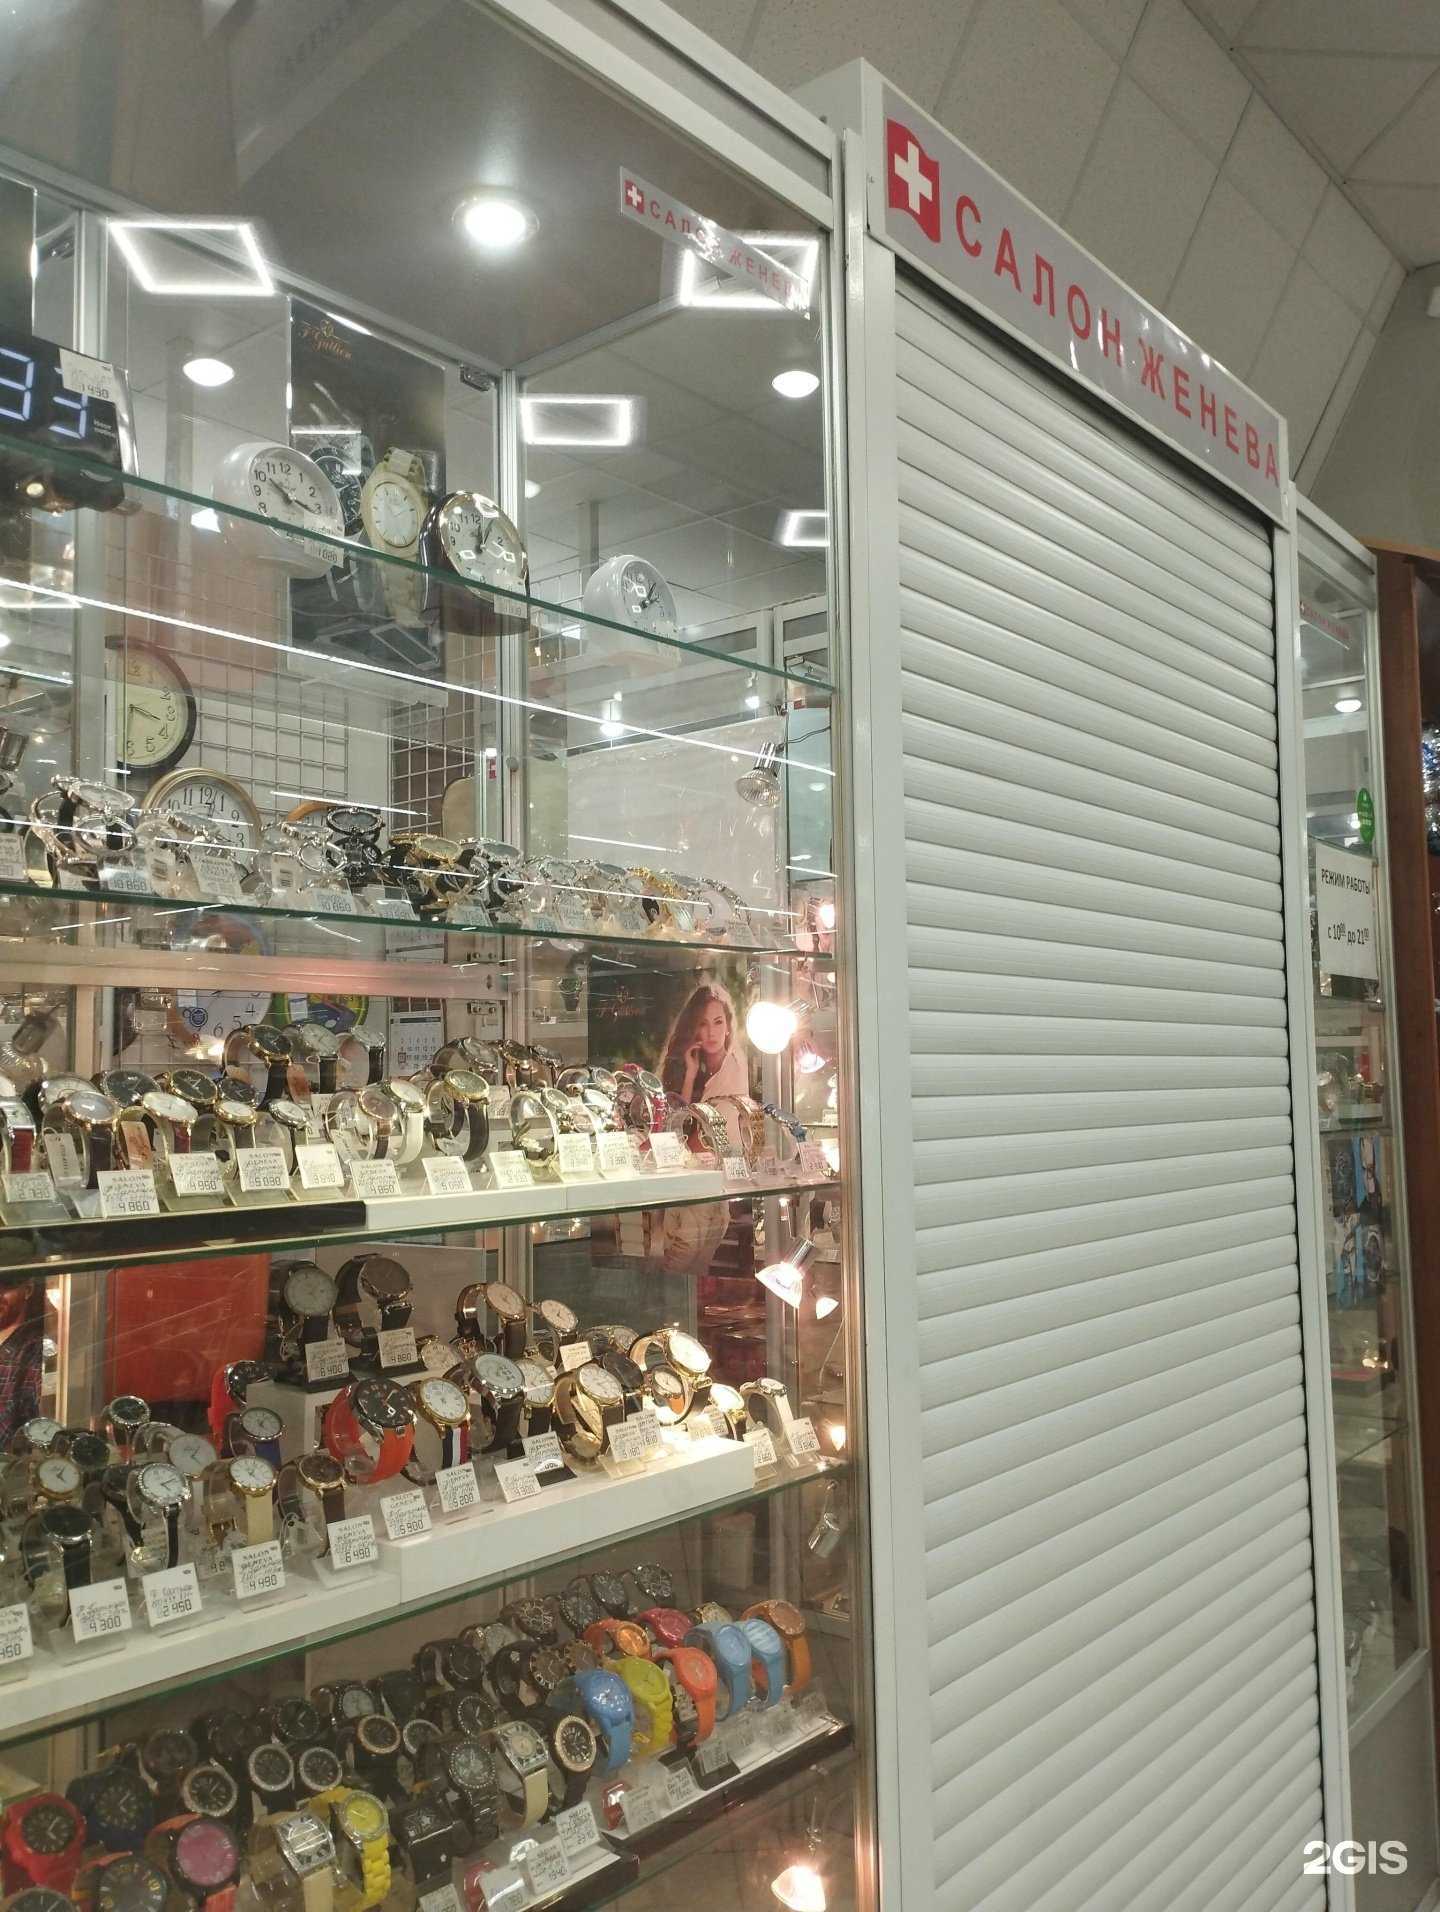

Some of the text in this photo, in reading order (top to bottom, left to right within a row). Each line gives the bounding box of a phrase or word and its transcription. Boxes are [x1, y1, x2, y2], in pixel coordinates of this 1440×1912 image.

[651, 201, 713, 250] САЛО
[955, 195, 1280, 488] САЛОН ЖЕНЕВА
[266, 462, 276, 474] 11
[280, 462, 291, 475] 12
[254, 470, 267, 482] 10
[253, 485, 262, 497] 9
[308, 486, 317, 498] 2
[167, 705, 176, 722] 3
[159, 725, 169, 740] 4
[183, 787, 193, 806] 11
[1321, 868, 1371, 895] РЕЖИМ РАБОТЫ
